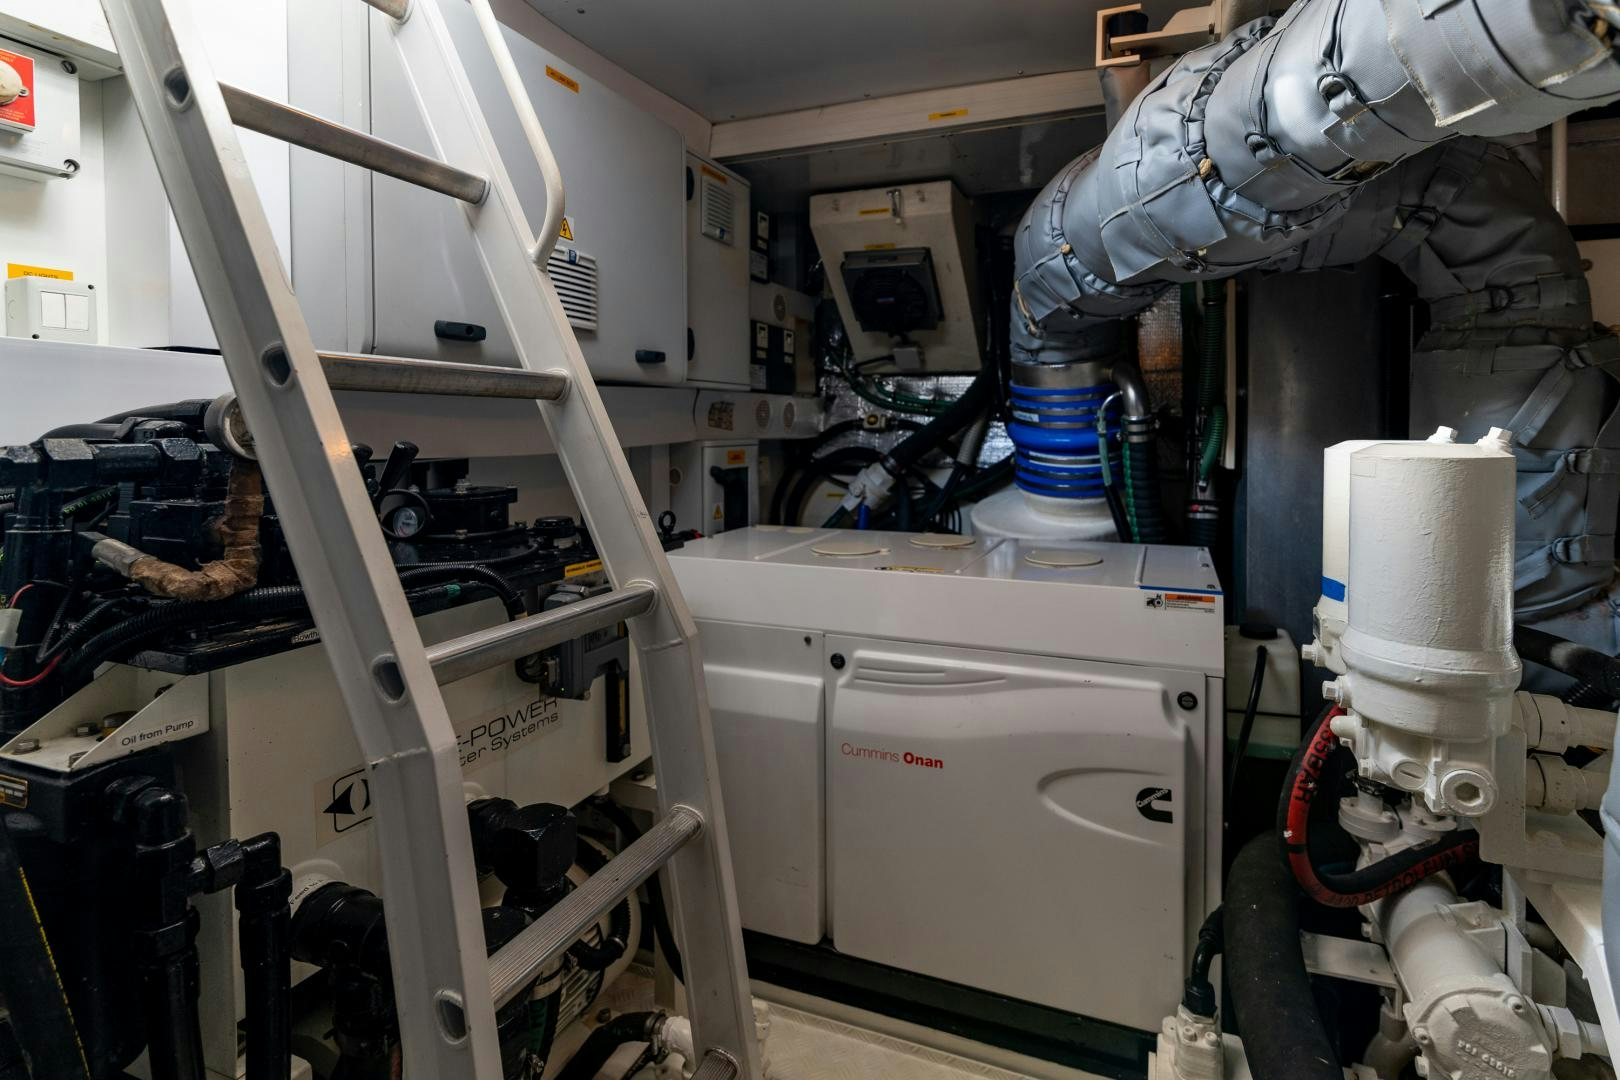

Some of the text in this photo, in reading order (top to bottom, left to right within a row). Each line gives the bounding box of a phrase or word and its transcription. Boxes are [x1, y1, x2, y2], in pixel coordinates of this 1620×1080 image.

[121, 720, 194, 746] Oil from Pump
[491, 712, 559, 751] Systems
[841, 742, 944, 769] Cummins Onan
